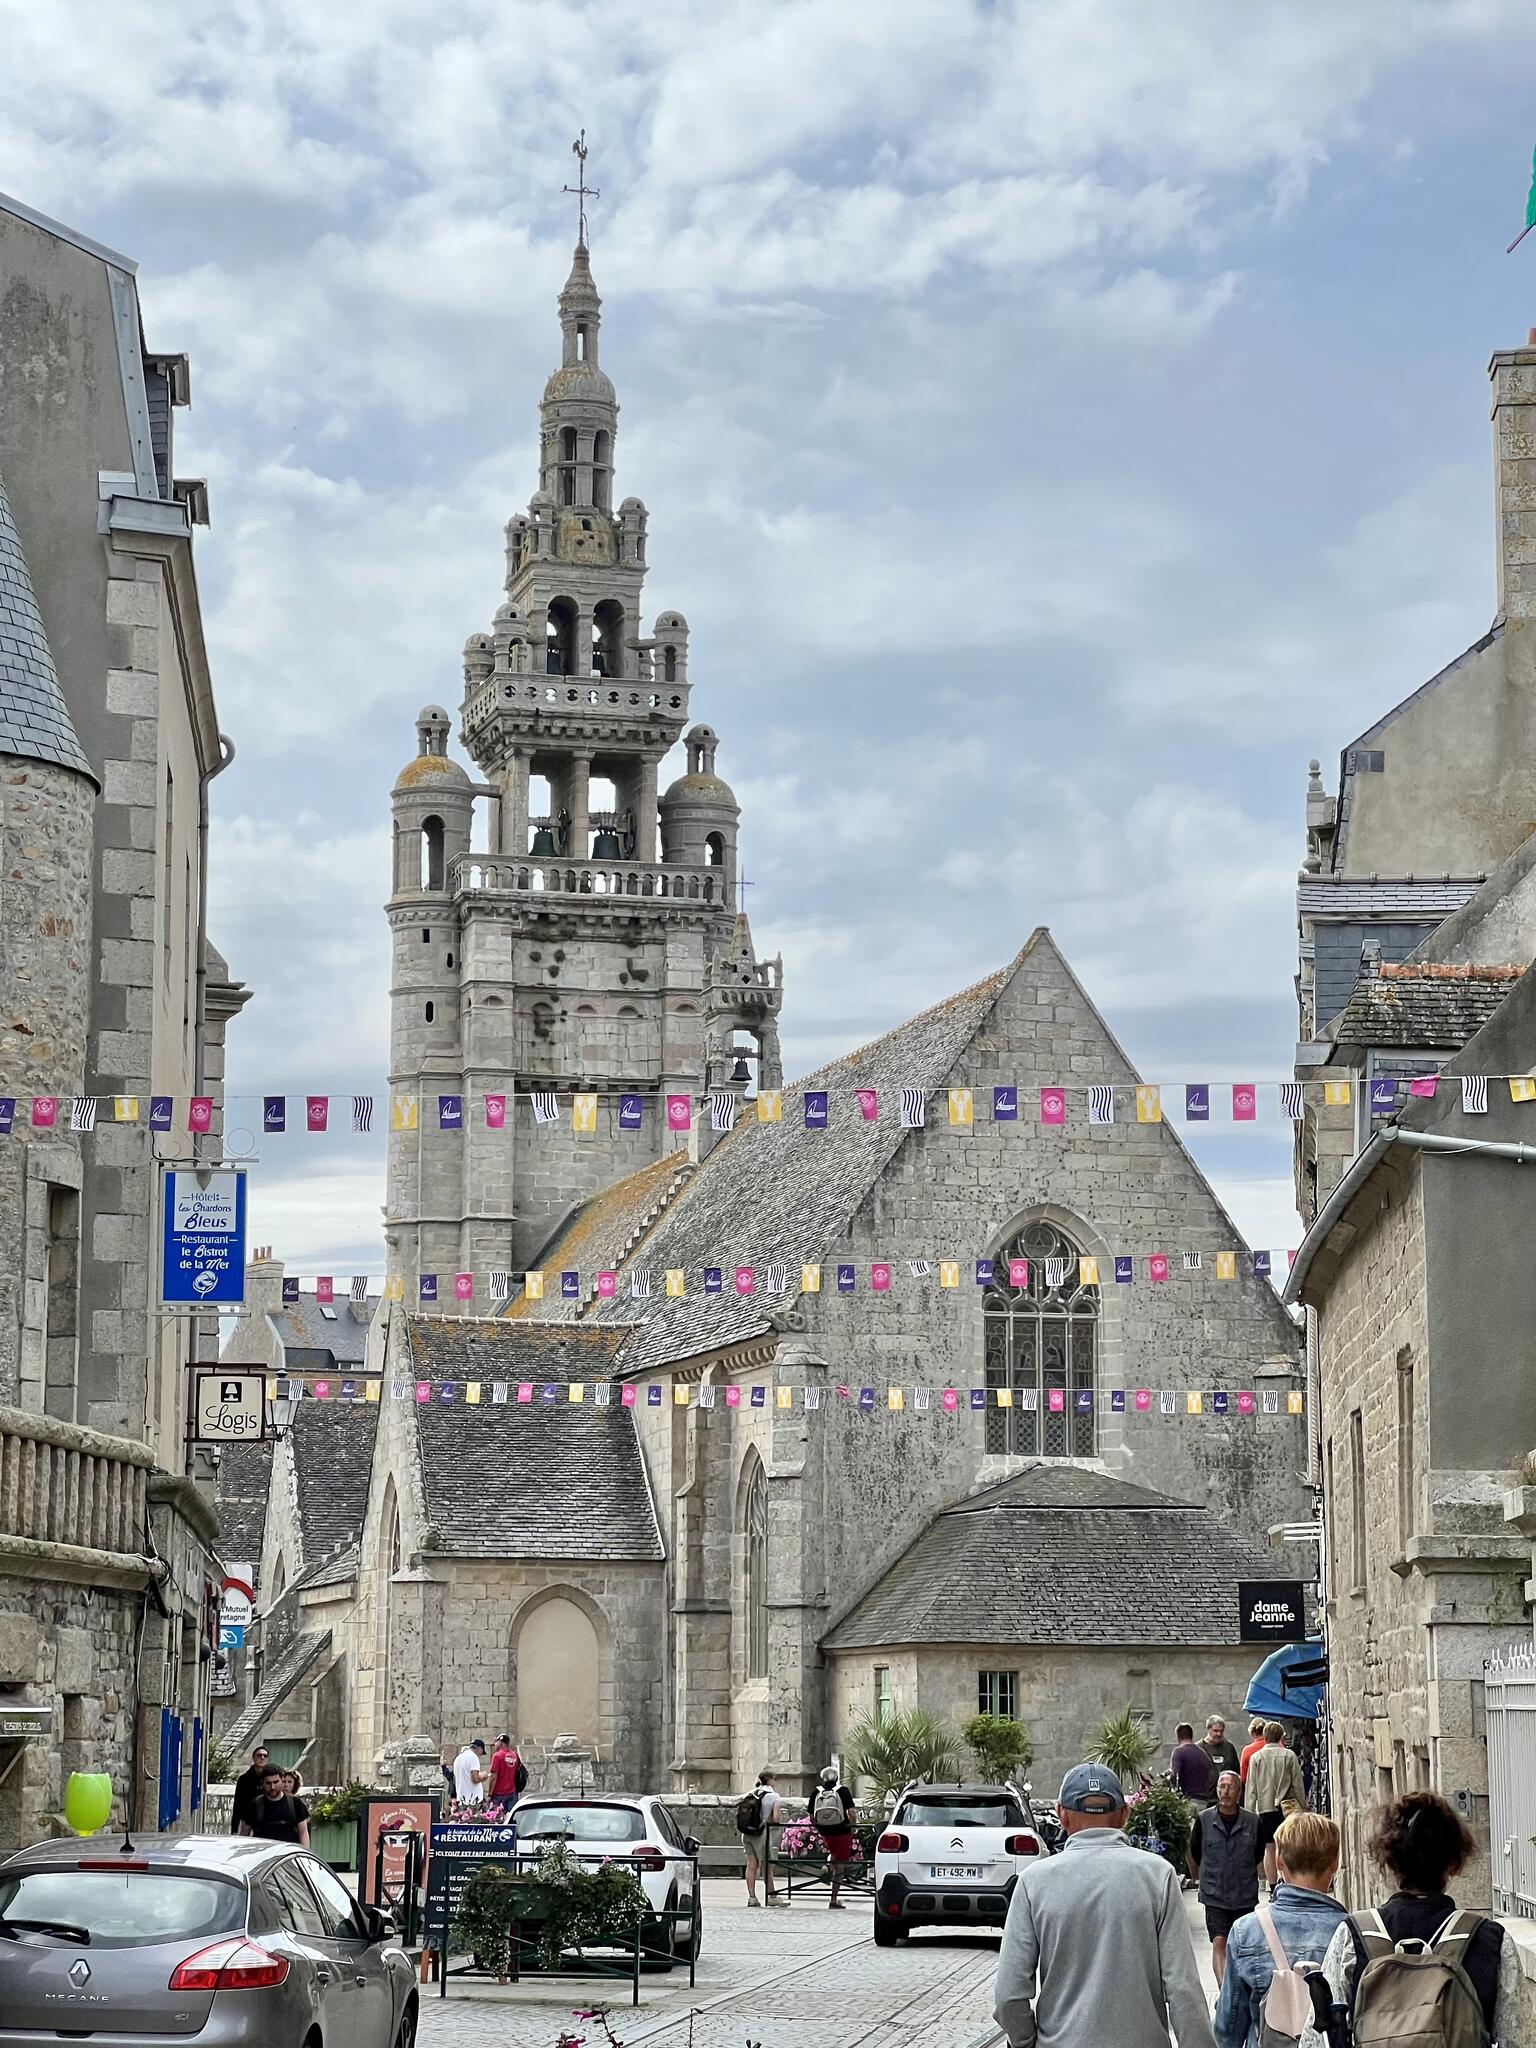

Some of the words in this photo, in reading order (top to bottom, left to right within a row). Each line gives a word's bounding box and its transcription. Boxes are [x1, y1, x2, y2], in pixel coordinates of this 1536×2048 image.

[192, 1202, 232, 1212] Chardons
[184, 1212, 228, 1230] Bleus
[181, 1234, 229, 1244] Restaurant
[181, 1246, 191, 1256] le
[194, 1244, 228, 1257] Bistrot
[179, 1259, 193, 1269] de
[194, 1259, 203, 1269] la
[205, 1258, 230, 1271] Mer
[203, 1403, 258, 1435] Logis
[225, 1605, 249, 1613] Mutuel
[1253, 1600, 1289, 1612] dame
[220, 1614, 246, 1623] retagne
[1249, 1611, 1295, 1622] Jeanne
[441, 1834, 497, 1843] RESTAURANT
